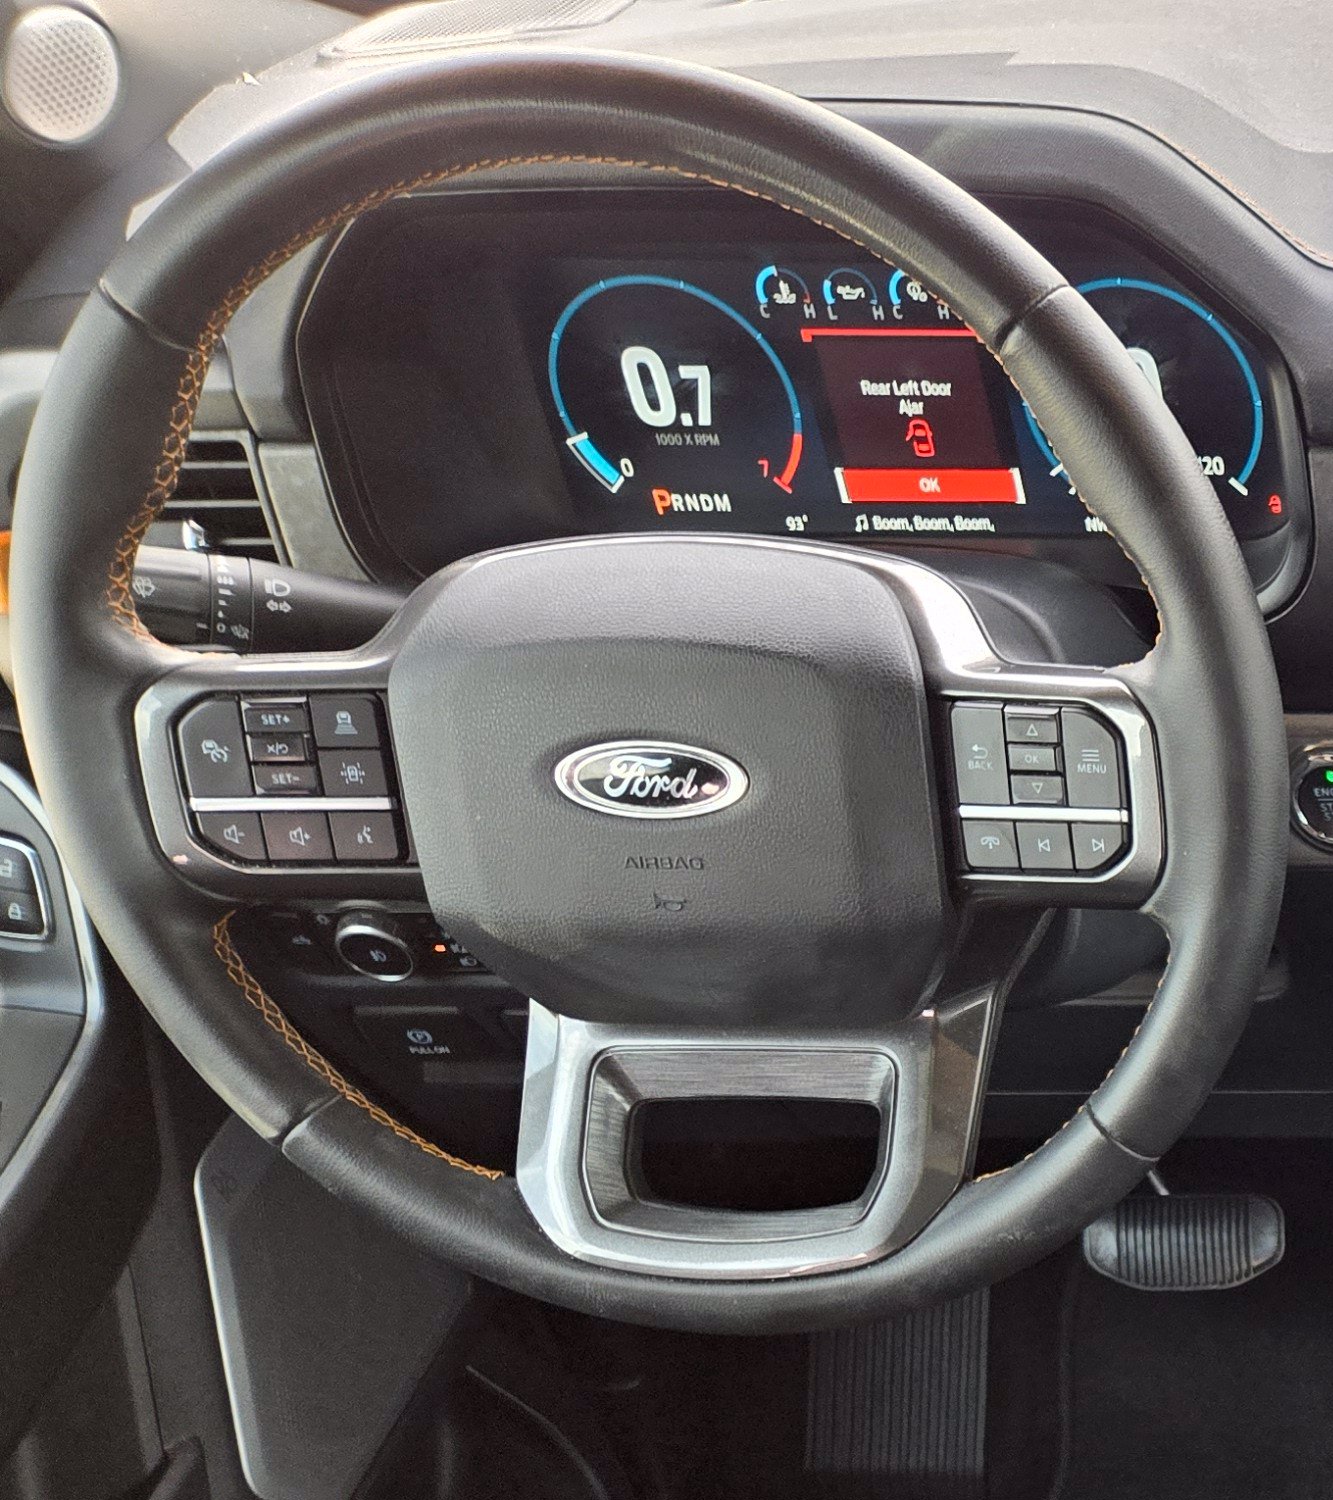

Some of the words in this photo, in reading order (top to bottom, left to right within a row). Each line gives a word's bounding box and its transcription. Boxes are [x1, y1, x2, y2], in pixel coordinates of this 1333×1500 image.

[759, 304, 771, 318] C
[803, 303, 817, 319] H
[826, 305, 838, 321] L
[872, 305, 885, 321] H
[892, 305, 903, 320] C
[937, 304, 950, 320] H
[621, 345, 712, 427] 0.7
[860, 379, 891, 396] Rear
[892, 379, 920, 397] Left
[920, 380, 952, 397] Door
[898, 398, 925, 417] Ajar
[655, 433, 682, 446] 1000
[695, 433, 720, 446] RPM
[620, 458, 634, 477] 0
[757, 458, 769, 478] 7
[1198, 456, 1225, 476] 20
[918, 477, 941, 493] OK
[871, 514, 914, 532] Boom,
[912, 514, 954, 532] Boom,
[953, 514, 996, 532] Boom,
[967, 760, 994, 771] BACK
[1024, 754, 1040, 764] OK
[603, 754, 698, 800] Ford
[1077, 764, 1107, 774] MENU
[623, 855, 706, 871] AIRBAG
